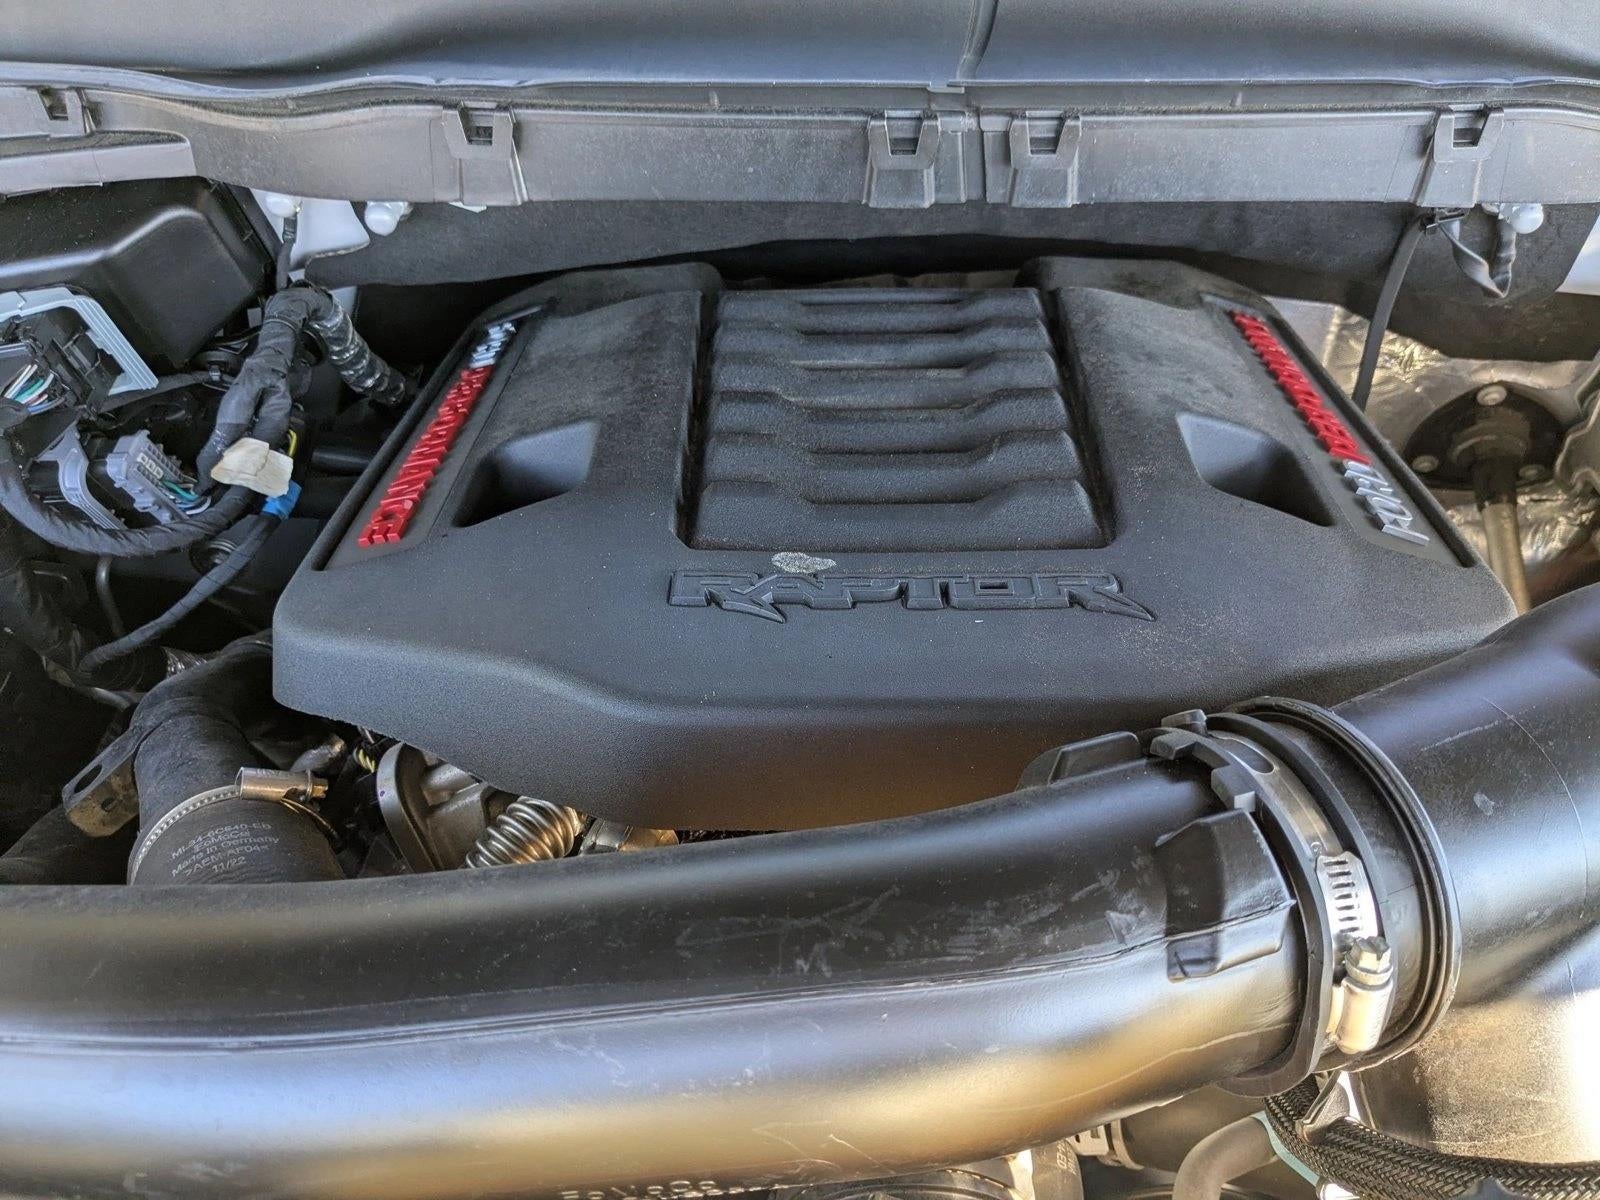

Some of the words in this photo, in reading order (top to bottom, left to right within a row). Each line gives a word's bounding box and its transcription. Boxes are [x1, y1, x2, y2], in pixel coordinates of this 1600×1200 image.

[357, 367, 493, 547] PERFORMANCE
[1343, 459, 1430, 546] FORD
[668, 570, 1156, 624] RAPTOR
